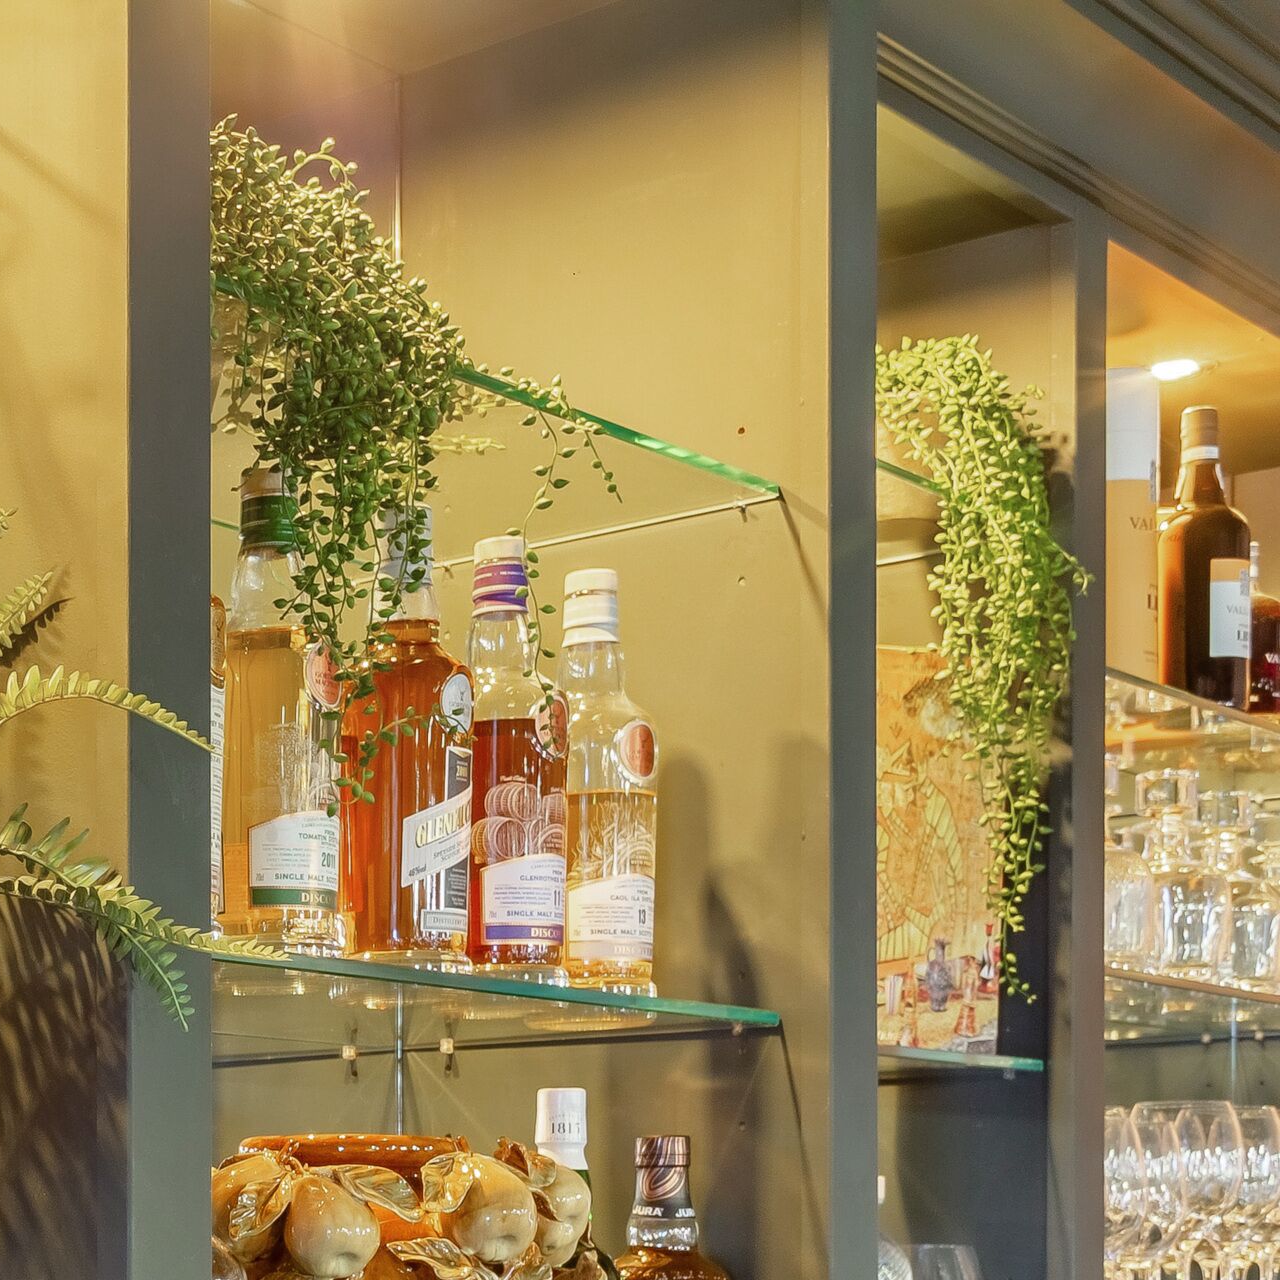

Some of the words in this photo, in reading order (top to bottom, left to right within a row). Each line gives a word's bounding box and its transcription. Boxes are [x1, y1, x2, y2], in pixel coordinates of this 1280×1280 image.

[274, 872, 305, 881] SINGLE
[307, 873, 325, 882] MALT
[506, 910, 535, 918] SINGLE
[536, 911, 553, 919] MALT
[590, 928, 618, 936] SINGLE
[620, 929, 637, 937] MALT
[632, 1204, 663, 1218] JURA
